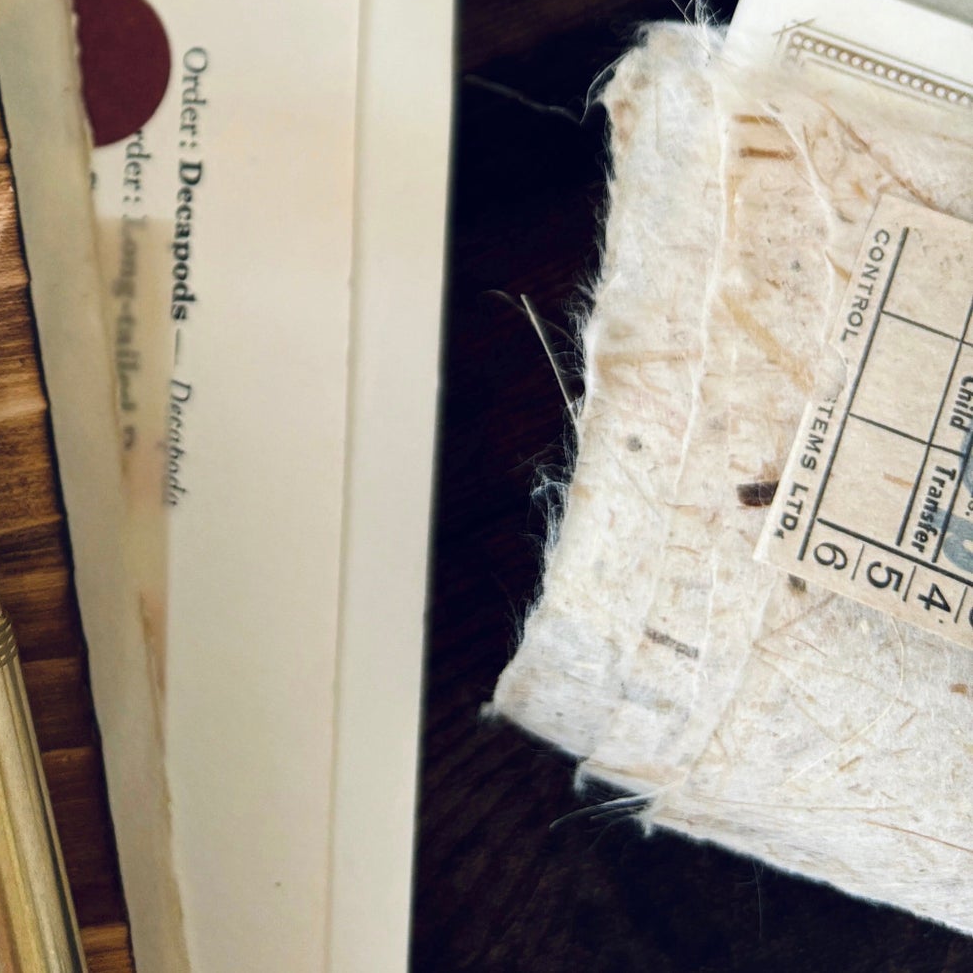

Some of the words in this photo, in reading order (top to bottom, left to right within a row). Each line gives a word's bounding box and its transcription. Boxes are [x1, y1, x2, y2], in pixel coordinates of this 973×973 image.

[179, 46, 210, 149] Order:
[122, 127, 151, 204] rder:
[170, 157, 203, 323] Decapods
[840, 228, 890, 343] CONTROL
[911, 465, 957, 554] Transfer
[812, 542, 848, 572] 6
[865, 559, 905, 590] 5
[916, 581, 952, 614] 4
